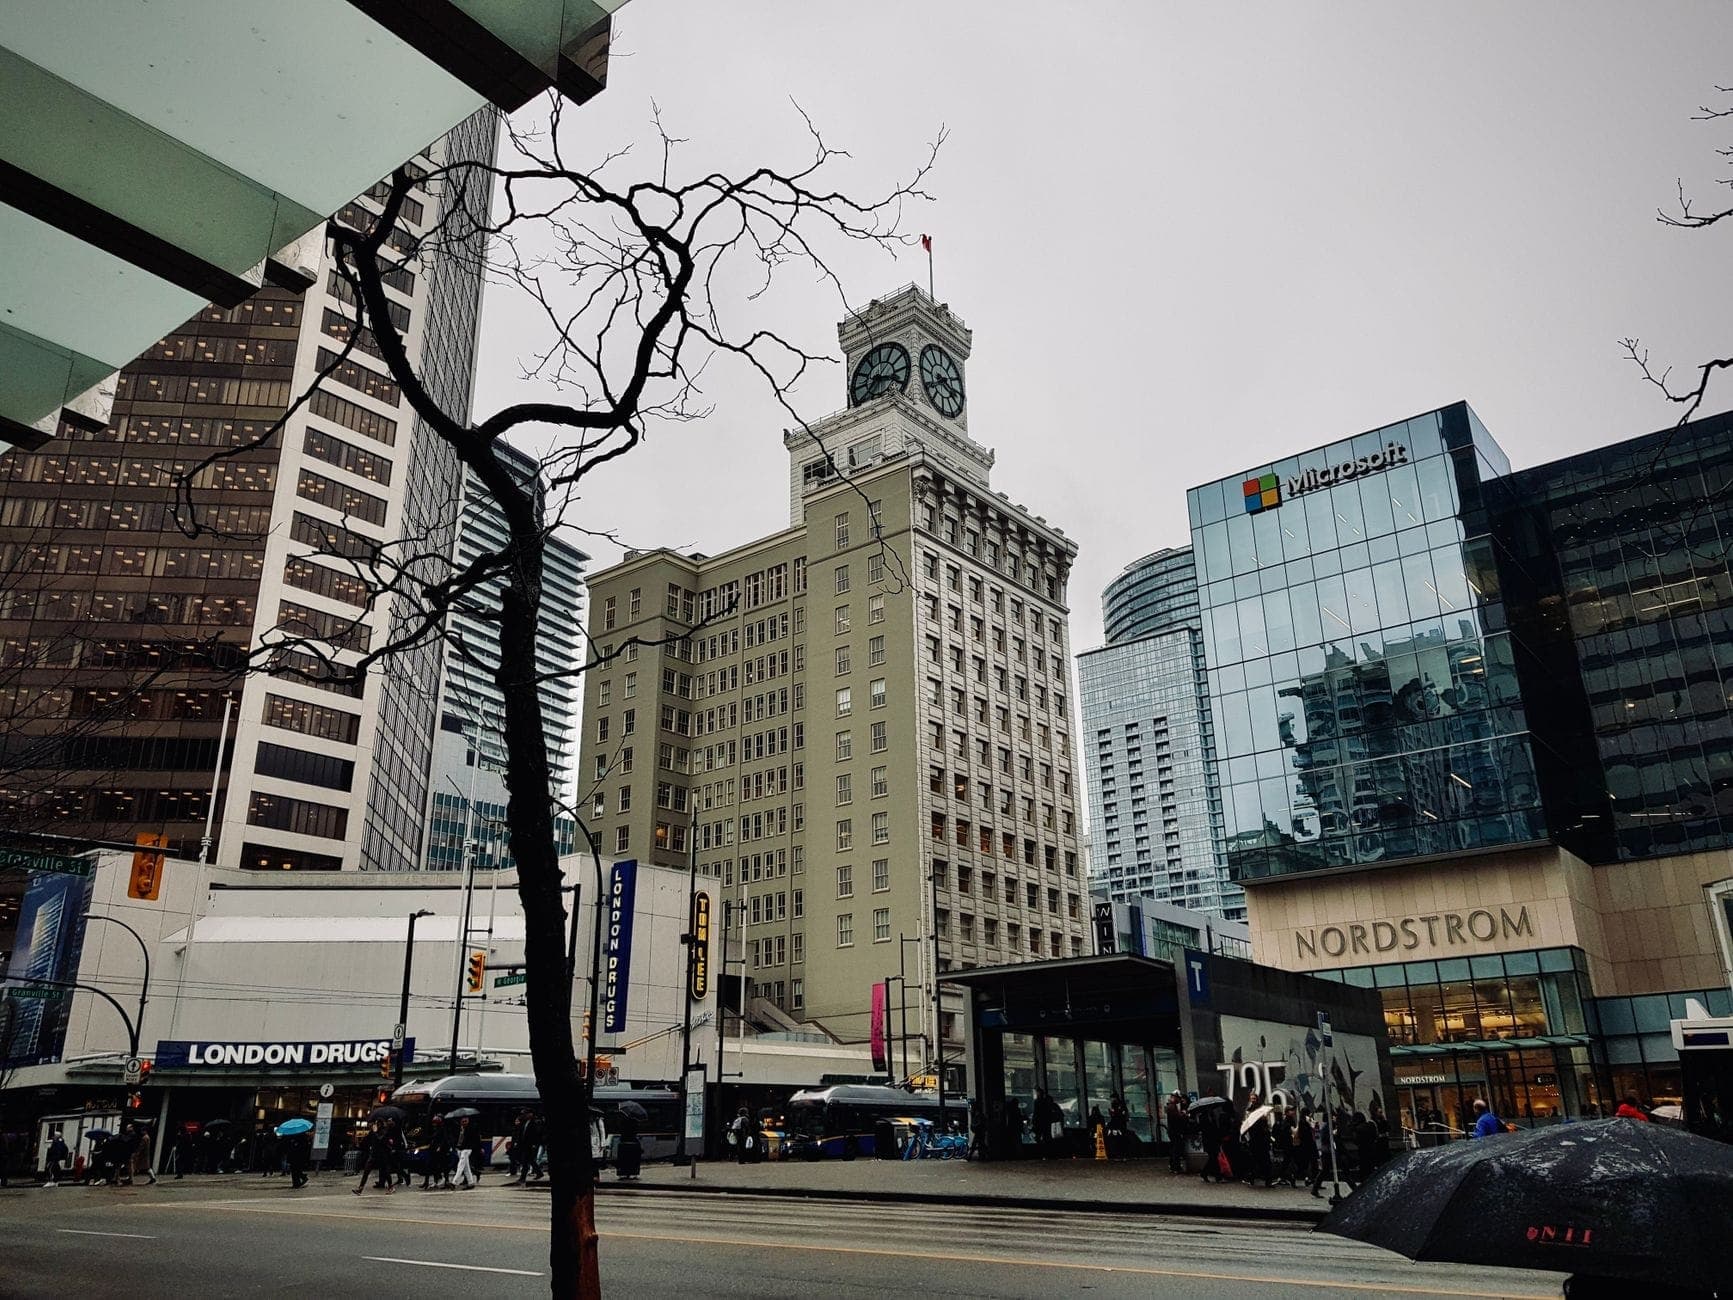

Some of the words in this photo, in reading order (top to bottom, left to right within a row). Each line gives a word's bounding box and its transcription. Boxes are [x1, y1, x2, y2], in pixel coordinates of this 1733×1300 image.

[1287, 441, 1406, 495] Microsoft
[69, 861, 82, 874] St
[610, 870, 622, 951] LONDON
[698, 899, 708, 941] TOM
[1296, 906, 1533, 958] NORDSTROM
[696, 947, 705, 991] LEE
[1190, 960, 1202, 991] T
[12, 988, 49, 997] Granville
[606, 957, 618, 1028] DRUGS
[188, 1043, 304, 1065] LONDON
[310, 1041, 390, 1063] DRUGS
[1400, 1074, 1446, 1084] NORDSTROM
